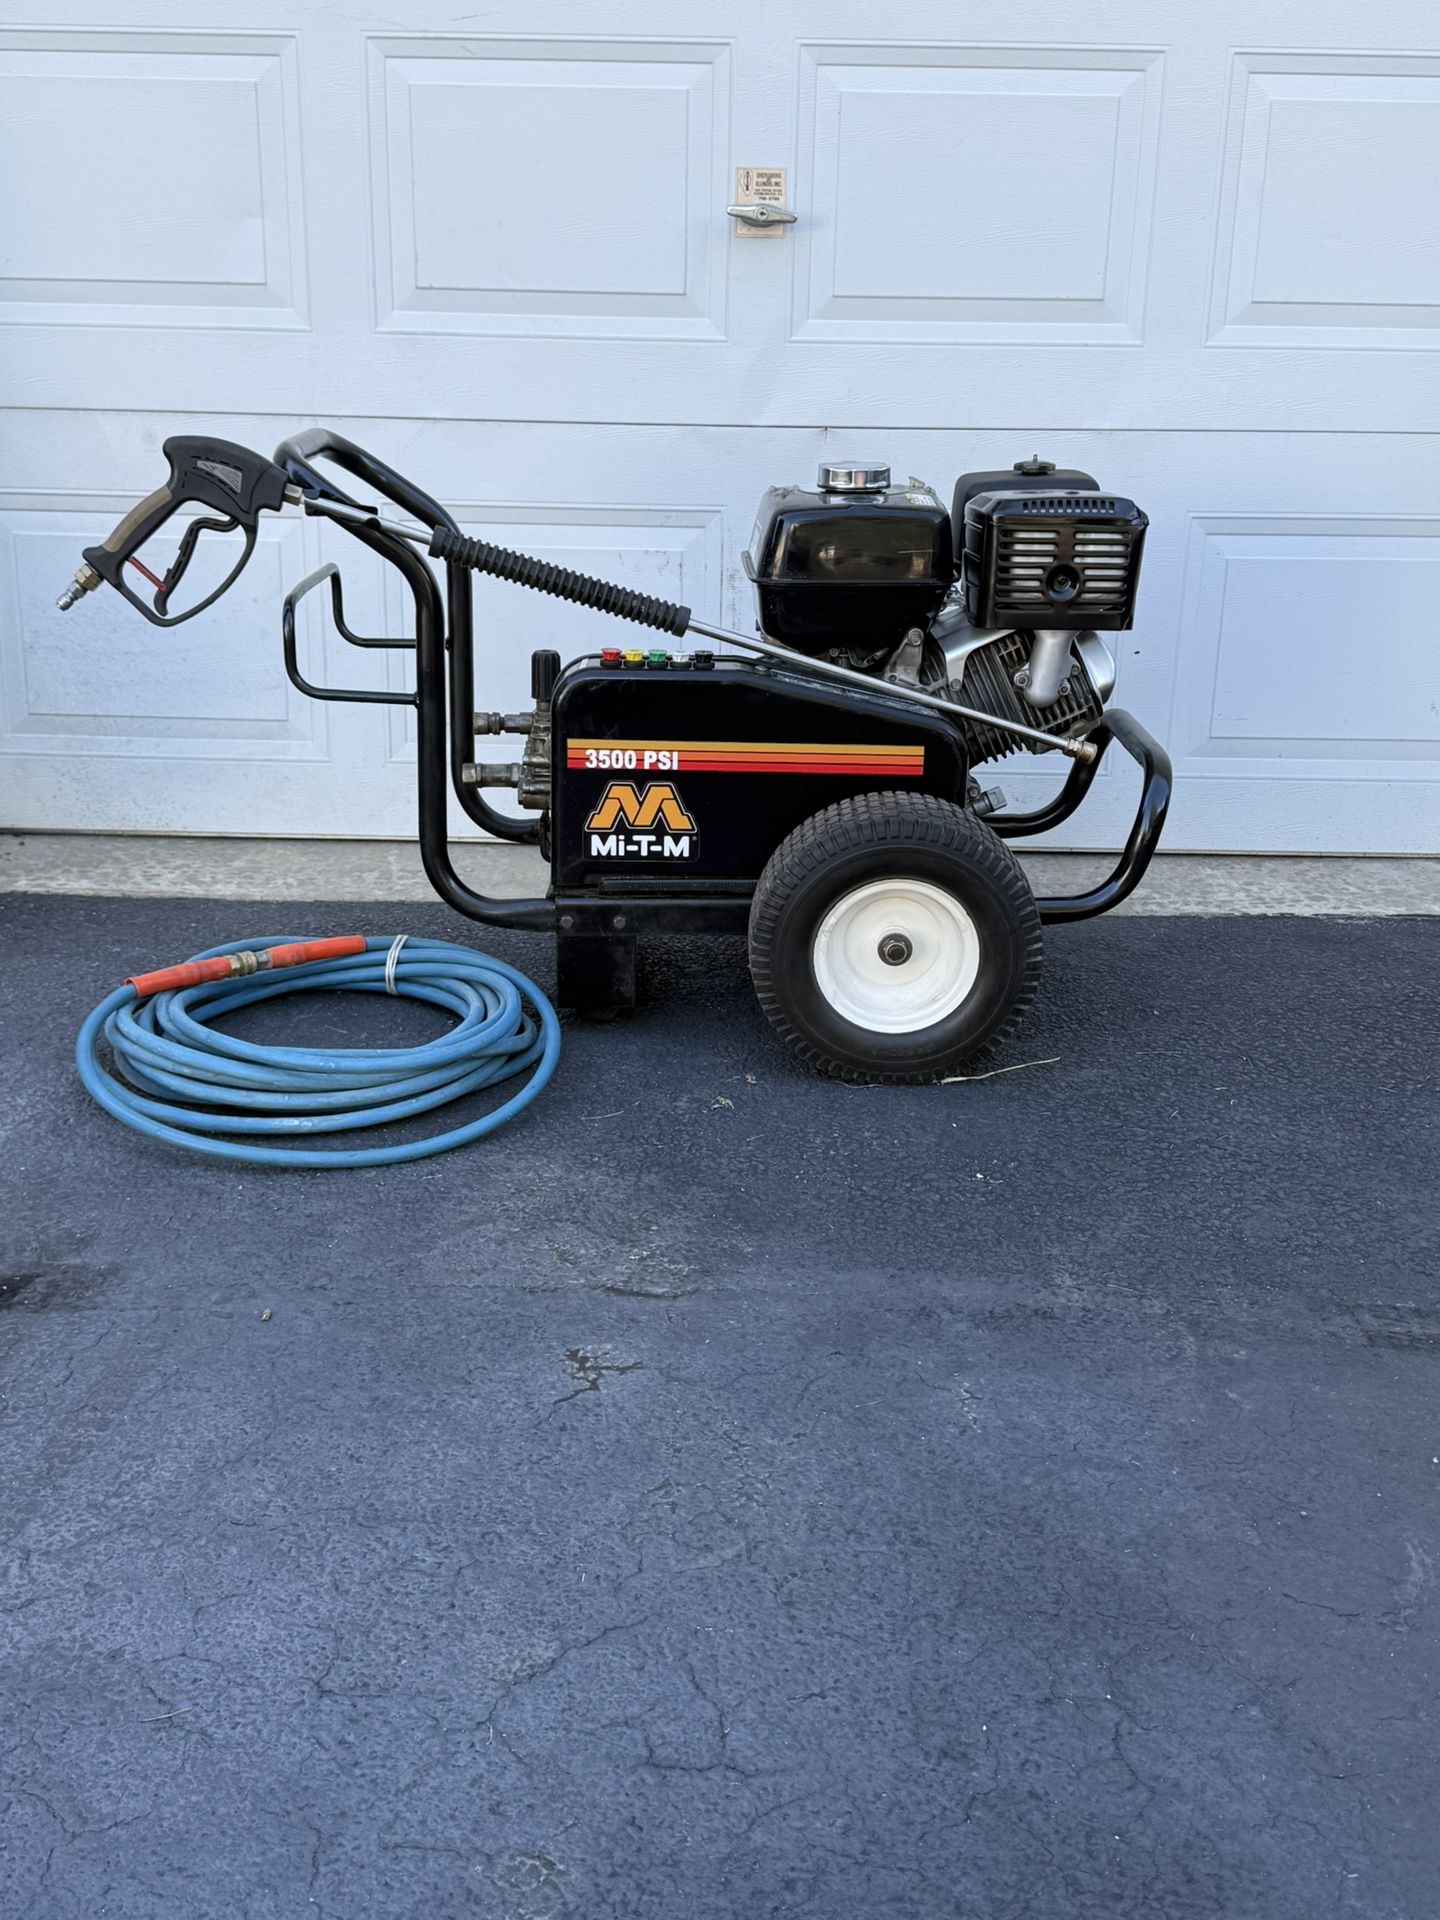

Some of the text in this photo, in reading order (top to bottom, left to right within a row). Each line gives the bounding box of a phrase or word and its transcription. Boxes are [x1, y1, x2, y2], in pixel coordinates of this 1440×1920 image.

[585, 749, 679, 771] 3500 PSI
[590, 834, 690, 857] Mi-T-M
